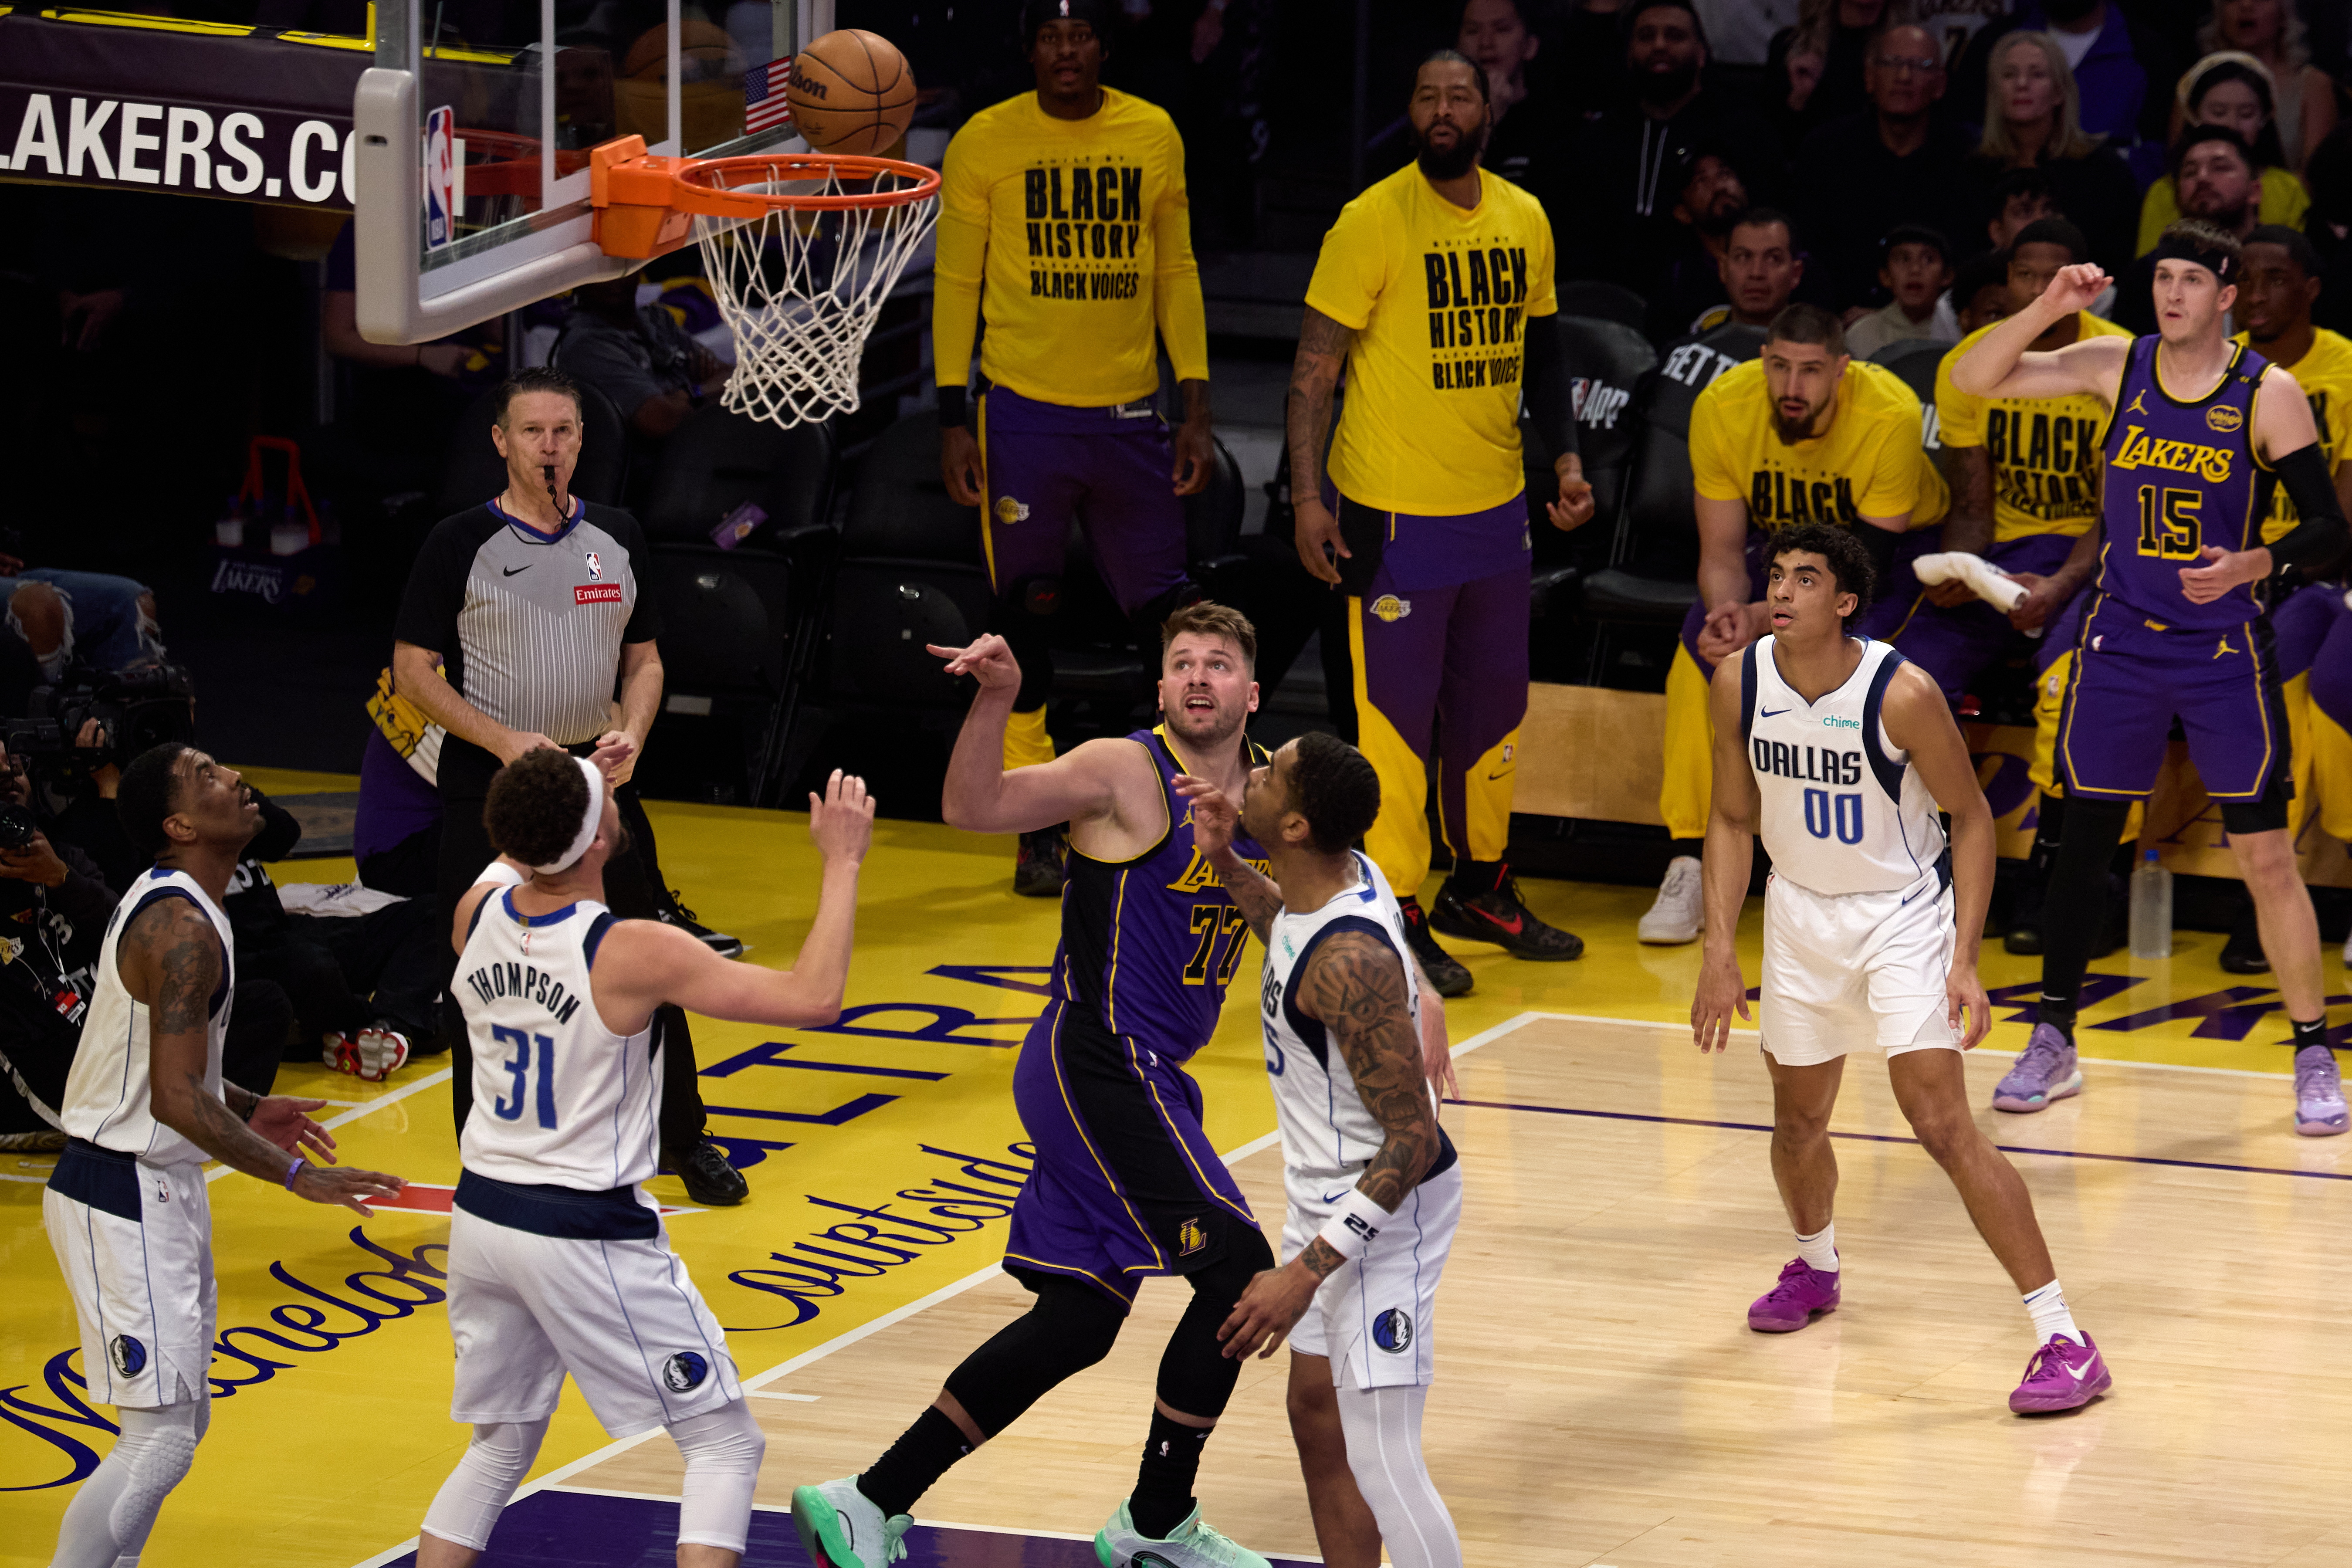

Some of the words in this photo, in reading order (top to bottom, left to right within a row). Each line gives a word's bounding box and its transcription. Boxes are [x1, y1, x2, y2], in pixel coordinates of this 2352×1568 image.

[0, 93, 355, 205] AKERS.C
[1026, 167, 1141, 221] BLACK
[1027, 223, 1138, 257] HISTORY
[1031, 271, 1086, 299] BLACK
[1091, 272, 1139, 300] VOICES
[1425, 248, 1527, 308] BLACK
[1433, 360, 1486, 389] BLACK
[1489, 356, 1520, 386] VOICE
[1660, 343, 1716, 386] GET
[1578, 378, 1630, 430] App
[1988, 409, 2096, 473] BLACK
[2110, 424, 2235, 484] LAKERS
[1752, 471, 1857, 524] BLACK
[2137, 484, 2203, 561] 15
[575, 587, 621, 601] Emirates
[1823, 715, 1860, 729] chime
[1753, 737, 1861, 785] DALLAS
[1804, 788, 1863, 845] 00
[1182, 904, 1250, 986] 77
[467, 962, 580, 1025] THOMPSON
[491, 1023, 557, 1131] 31
